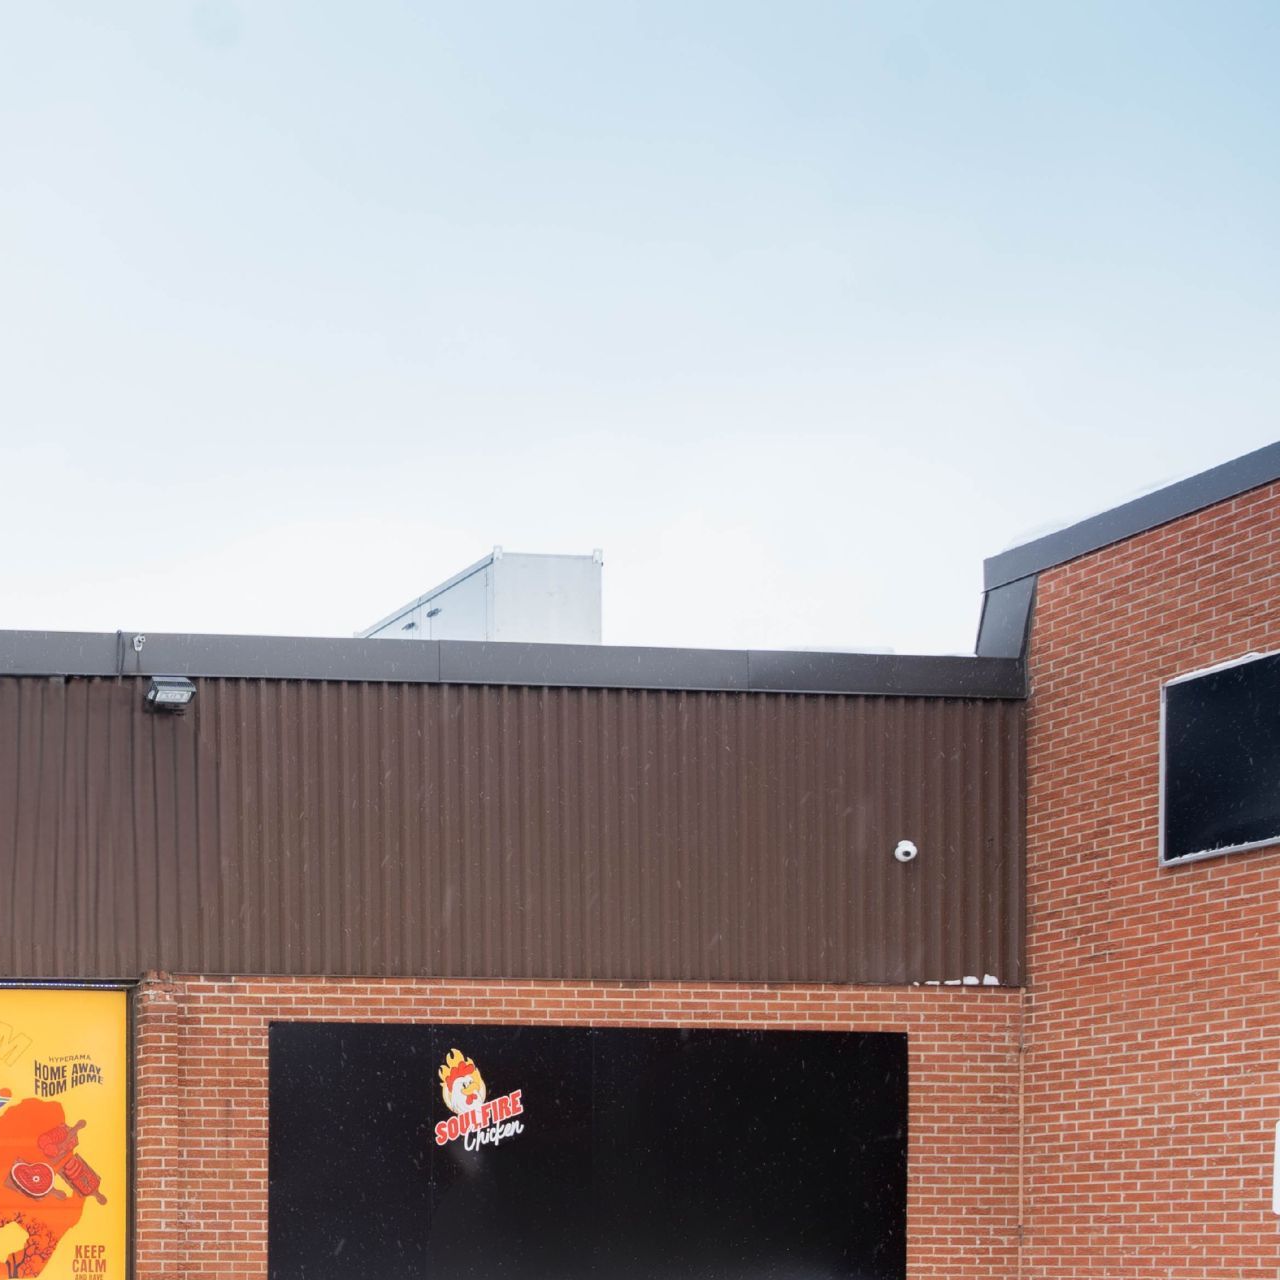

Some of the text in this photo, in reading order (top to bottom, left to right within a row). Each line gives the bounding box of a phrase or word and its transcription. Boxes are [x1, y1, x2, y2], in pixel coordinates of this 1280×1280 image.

[48, 1054, 92, 1063] HYPERAMA
[34, 1059, 102, 1081] HOME AWAY
[34, 1073, 104, 1098] FROM HOME
[463, 1120, 525, 1152] Chicken
[75, 1244, 105, 1259] KEEP
[72, 1259, 107, 1273] CALM
